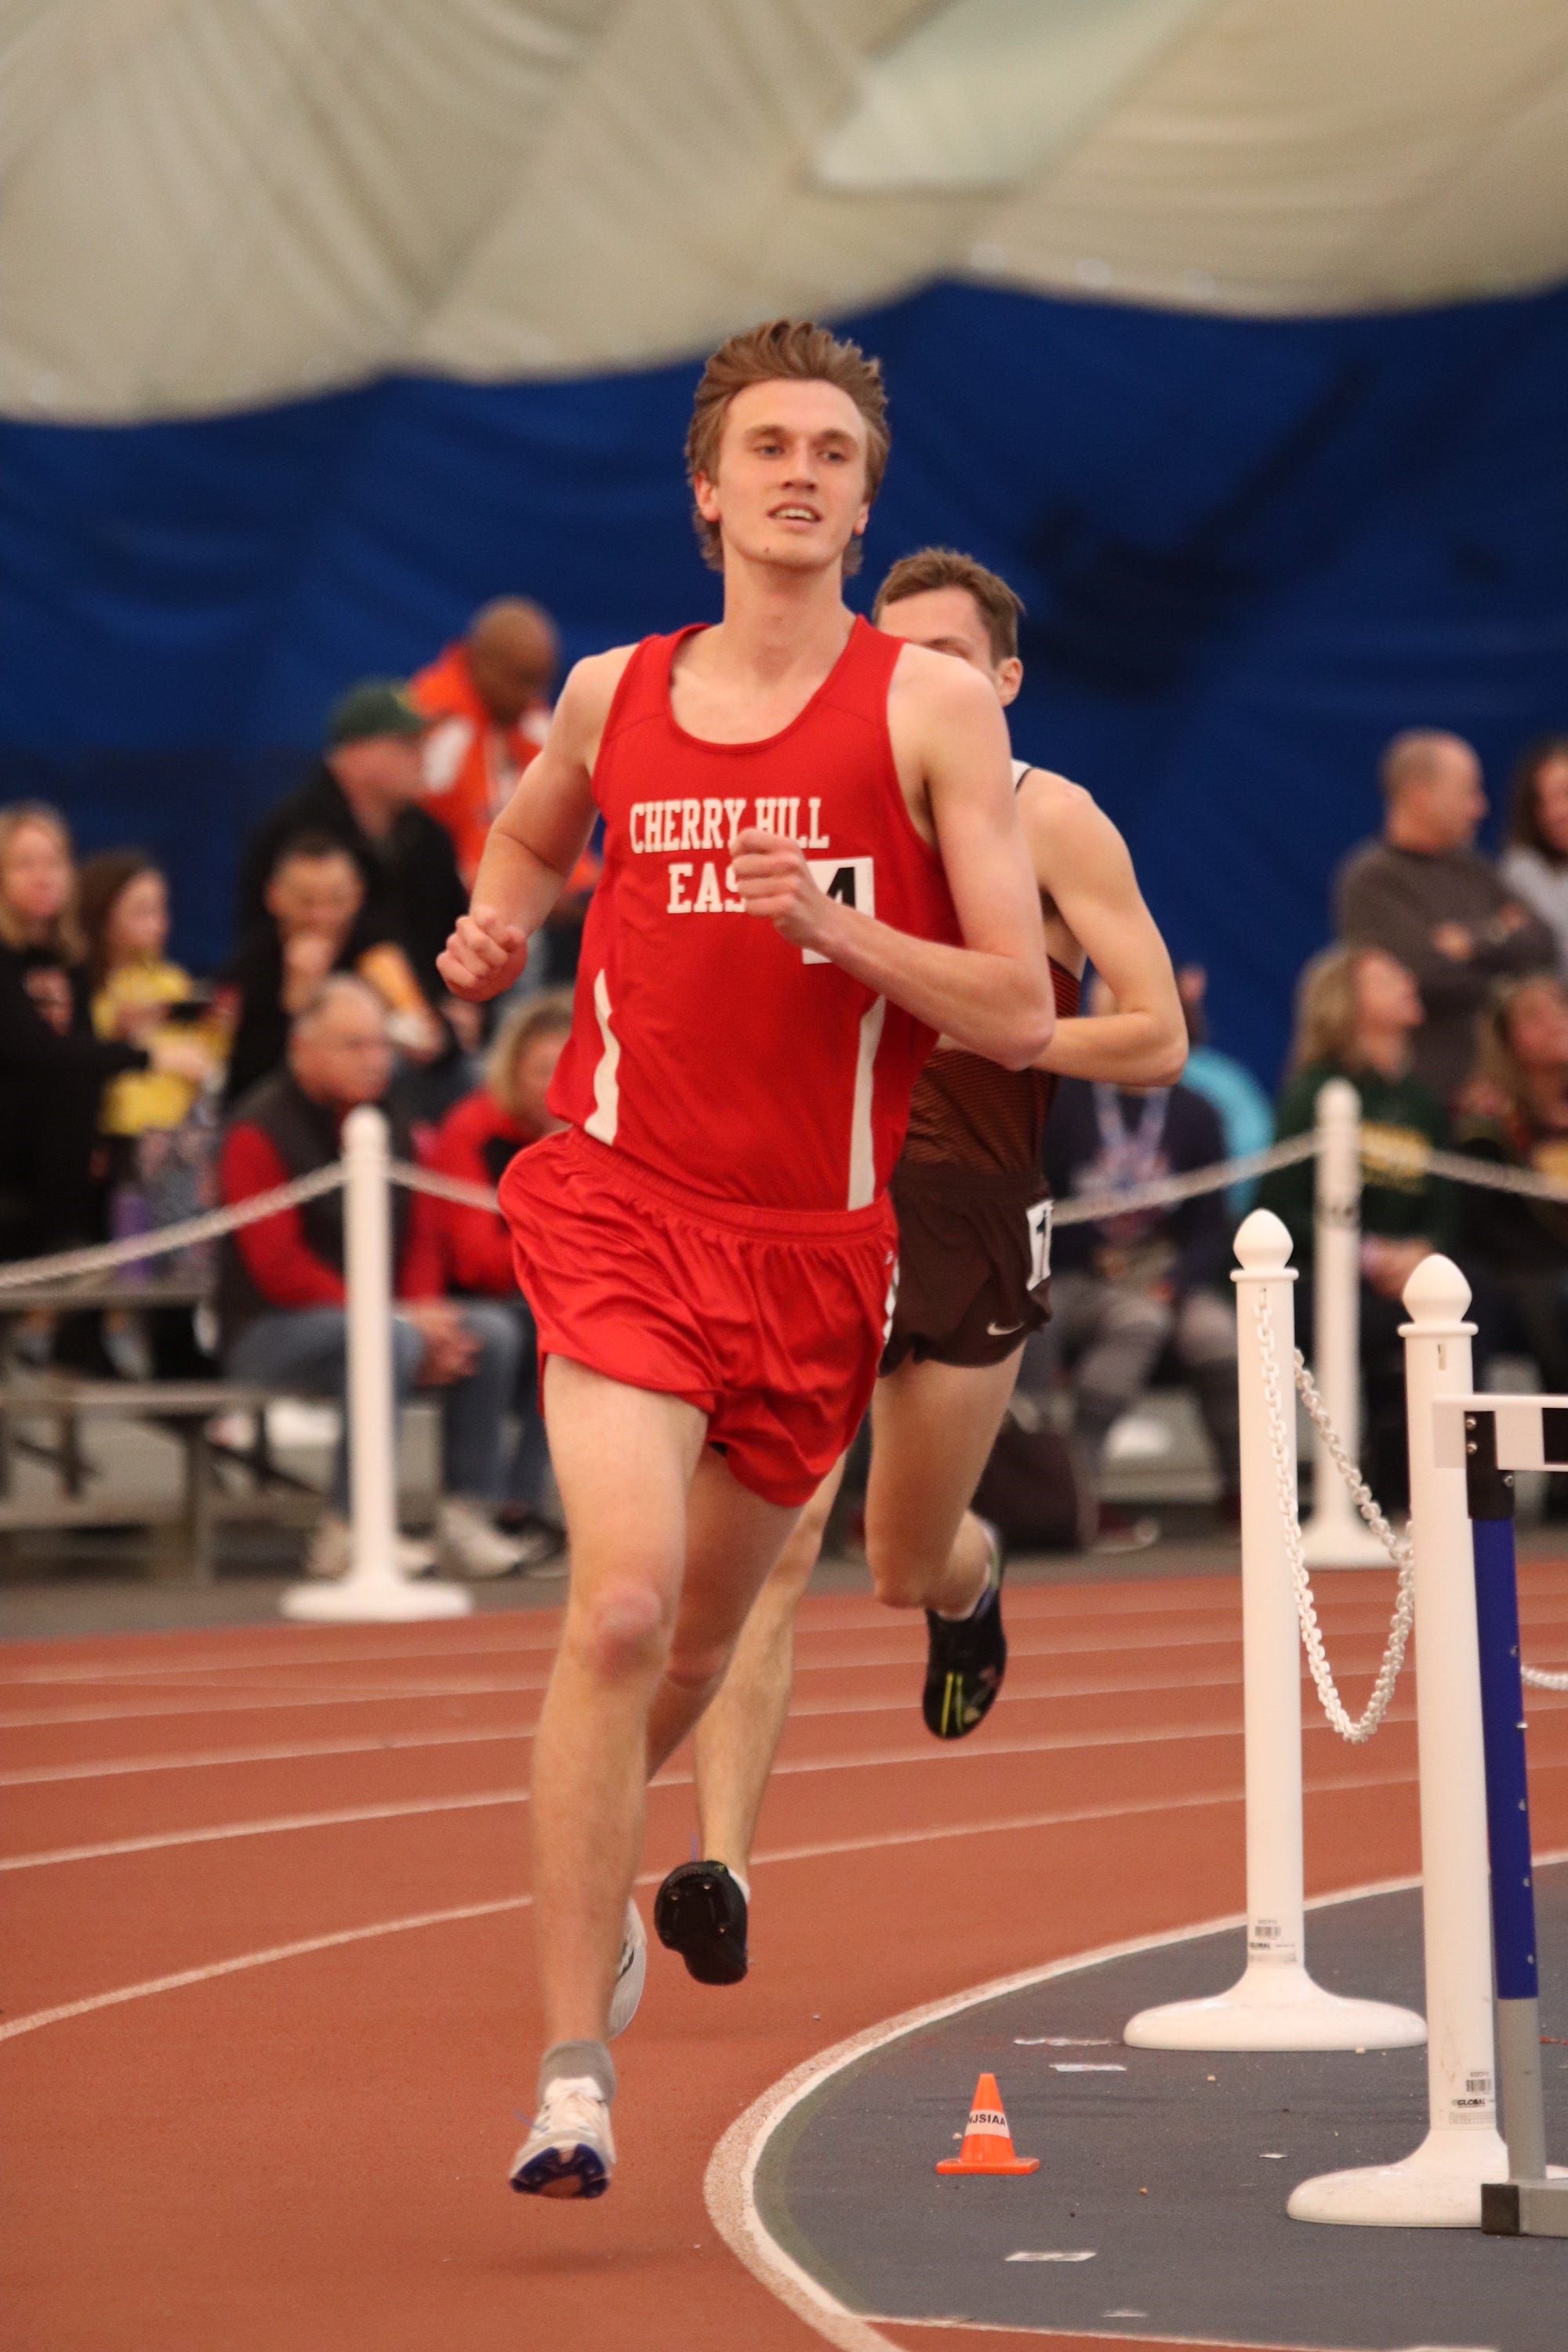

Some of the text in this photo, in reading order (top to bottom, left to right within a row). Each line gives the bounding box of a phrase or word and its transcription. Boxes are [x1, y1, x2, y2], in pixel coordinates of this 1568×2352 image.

[630, 797, 829, 854] CHERRY HILL
[666, 862, 746, 914] EAS
